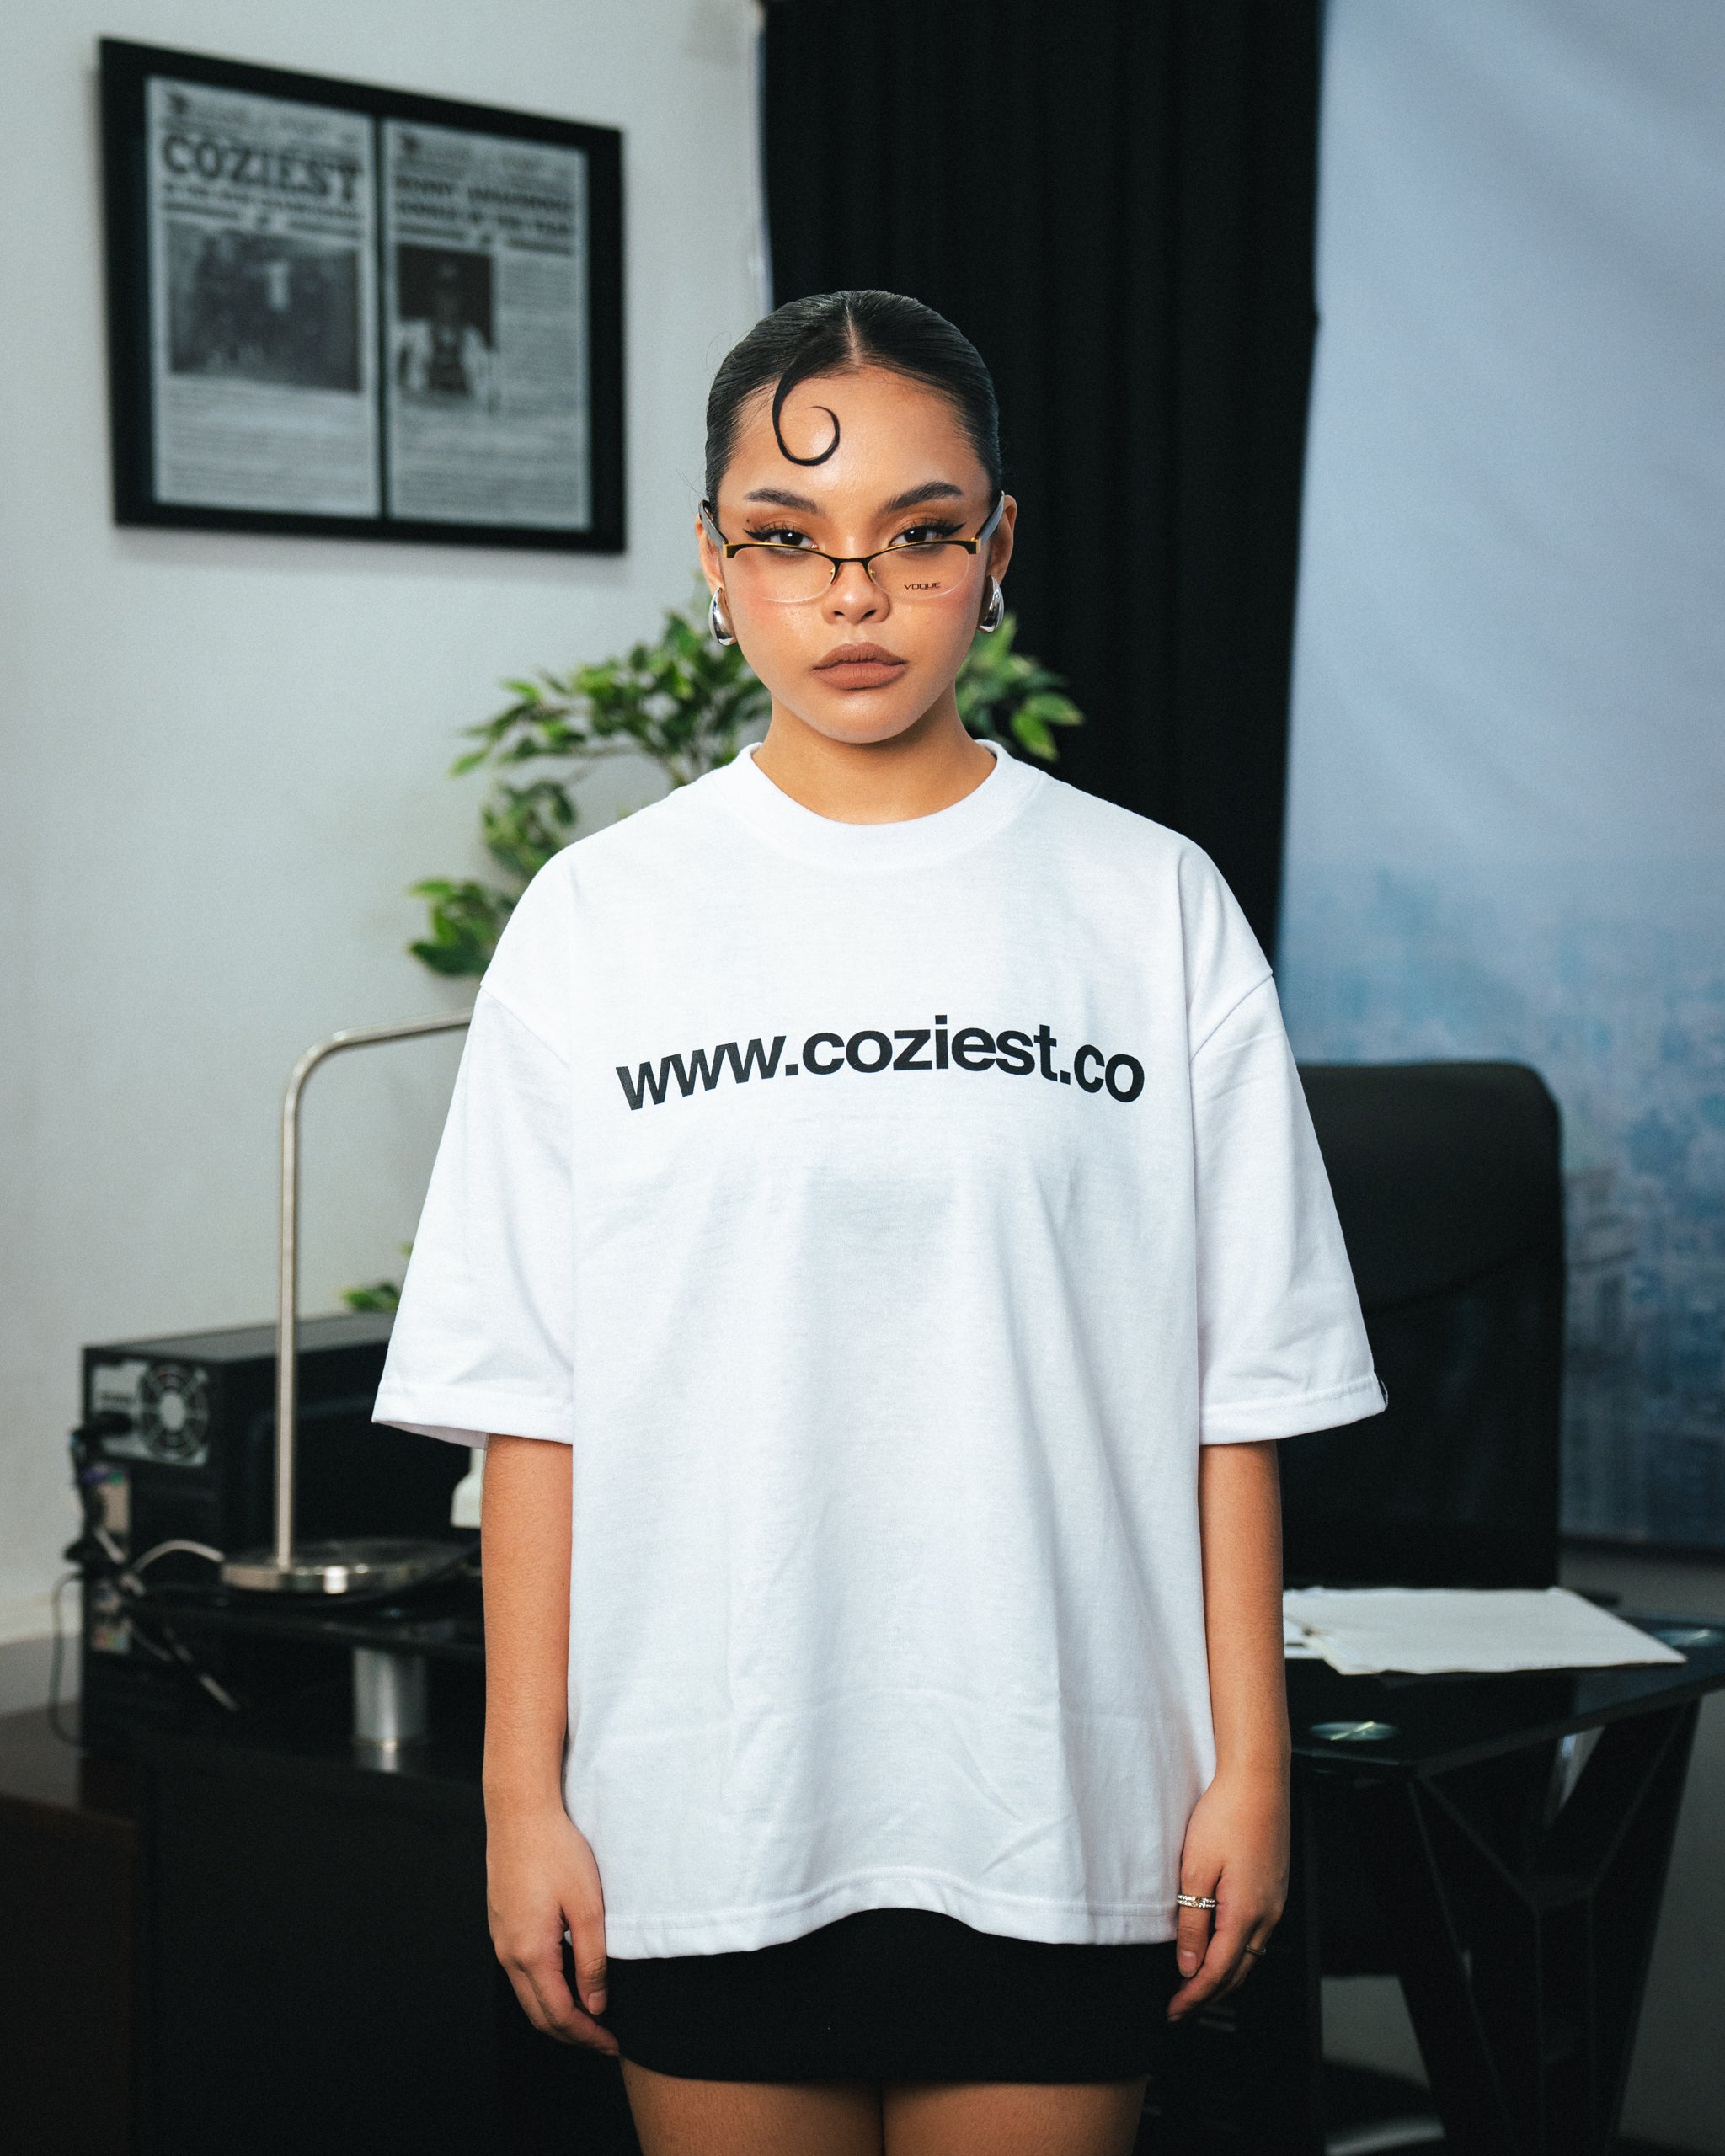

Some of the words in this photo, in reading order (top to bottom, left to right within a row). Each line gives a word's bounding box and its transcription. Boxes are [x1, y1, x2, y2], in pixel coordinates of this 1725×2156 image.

[162, 135, 363, 203] COZIEST
[904, 582, 941, 590] VOGUE
[616, 1015, 1144, 1110] www.coziest.co
